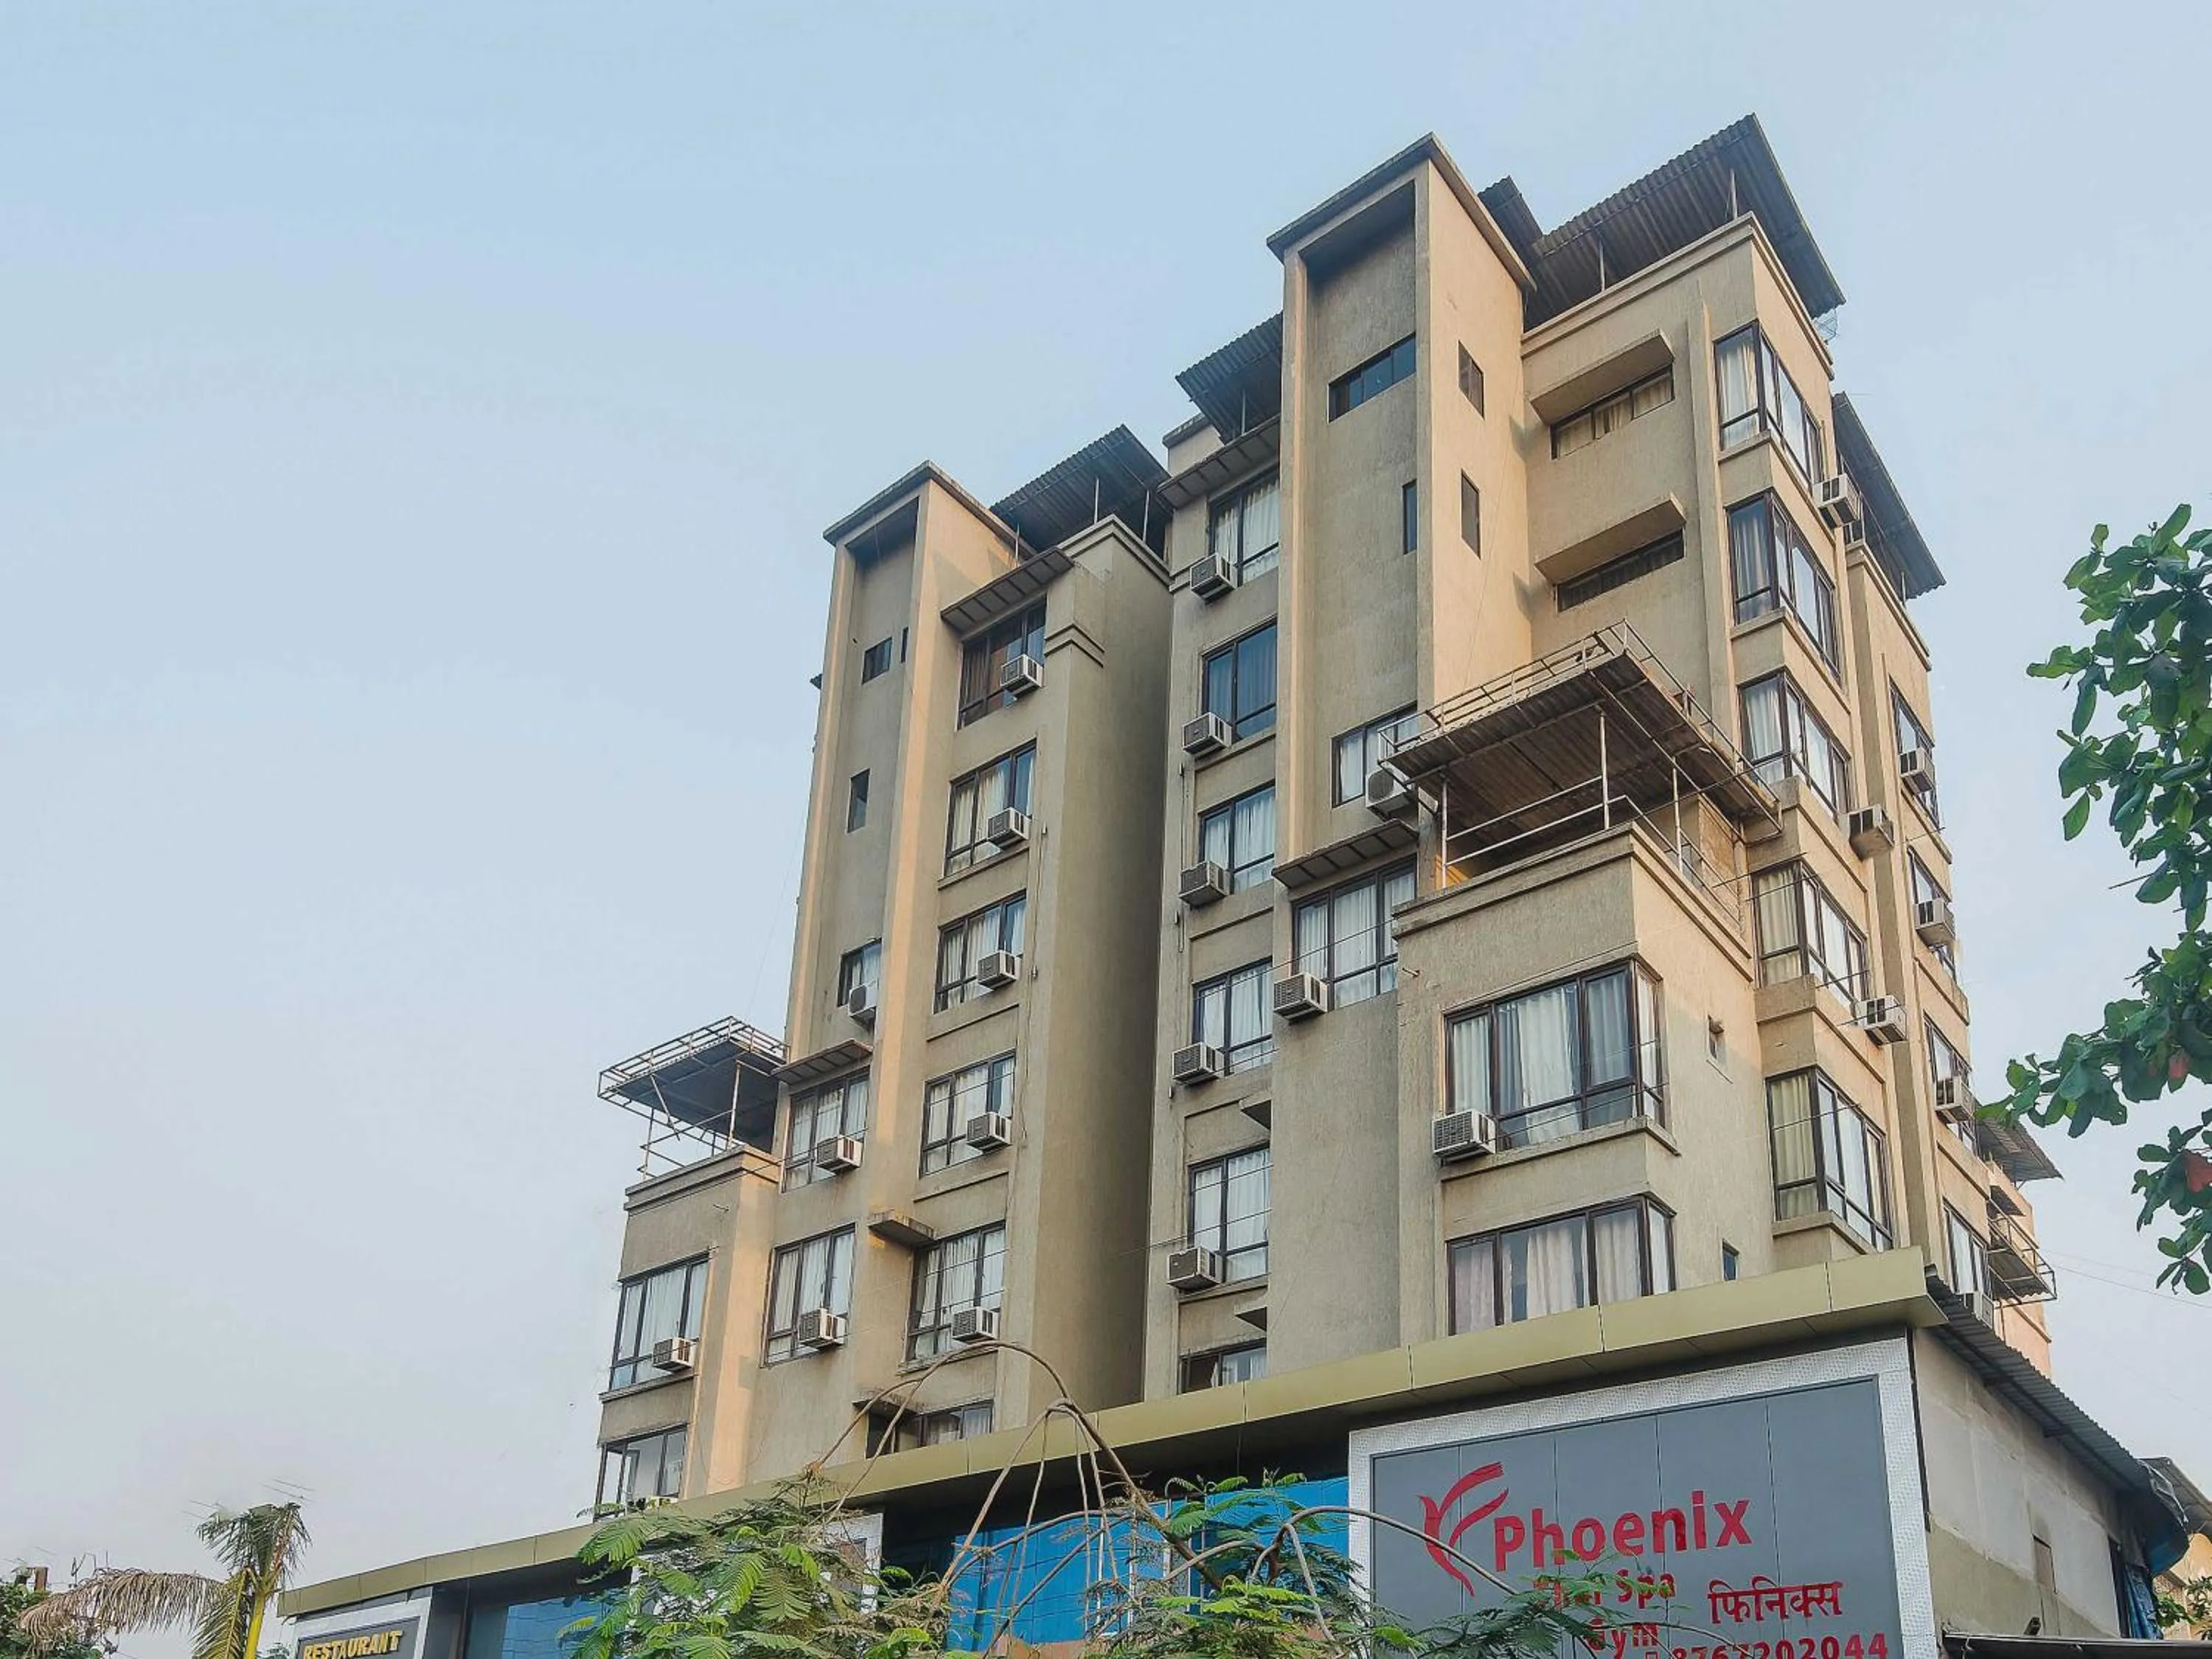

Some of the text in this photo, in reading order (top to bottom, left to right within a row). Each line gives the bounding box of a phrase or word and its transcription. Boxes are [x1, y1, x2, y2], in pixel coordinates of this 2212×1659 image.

[1494, 1490, 1752, 1572] Phoenix
[1616, 1568, 1675, 1609] Spa
[1708, 1576, 1843, 1624] फिनिक्स
[303, 1630, 403, 1659] RESTAURANT
